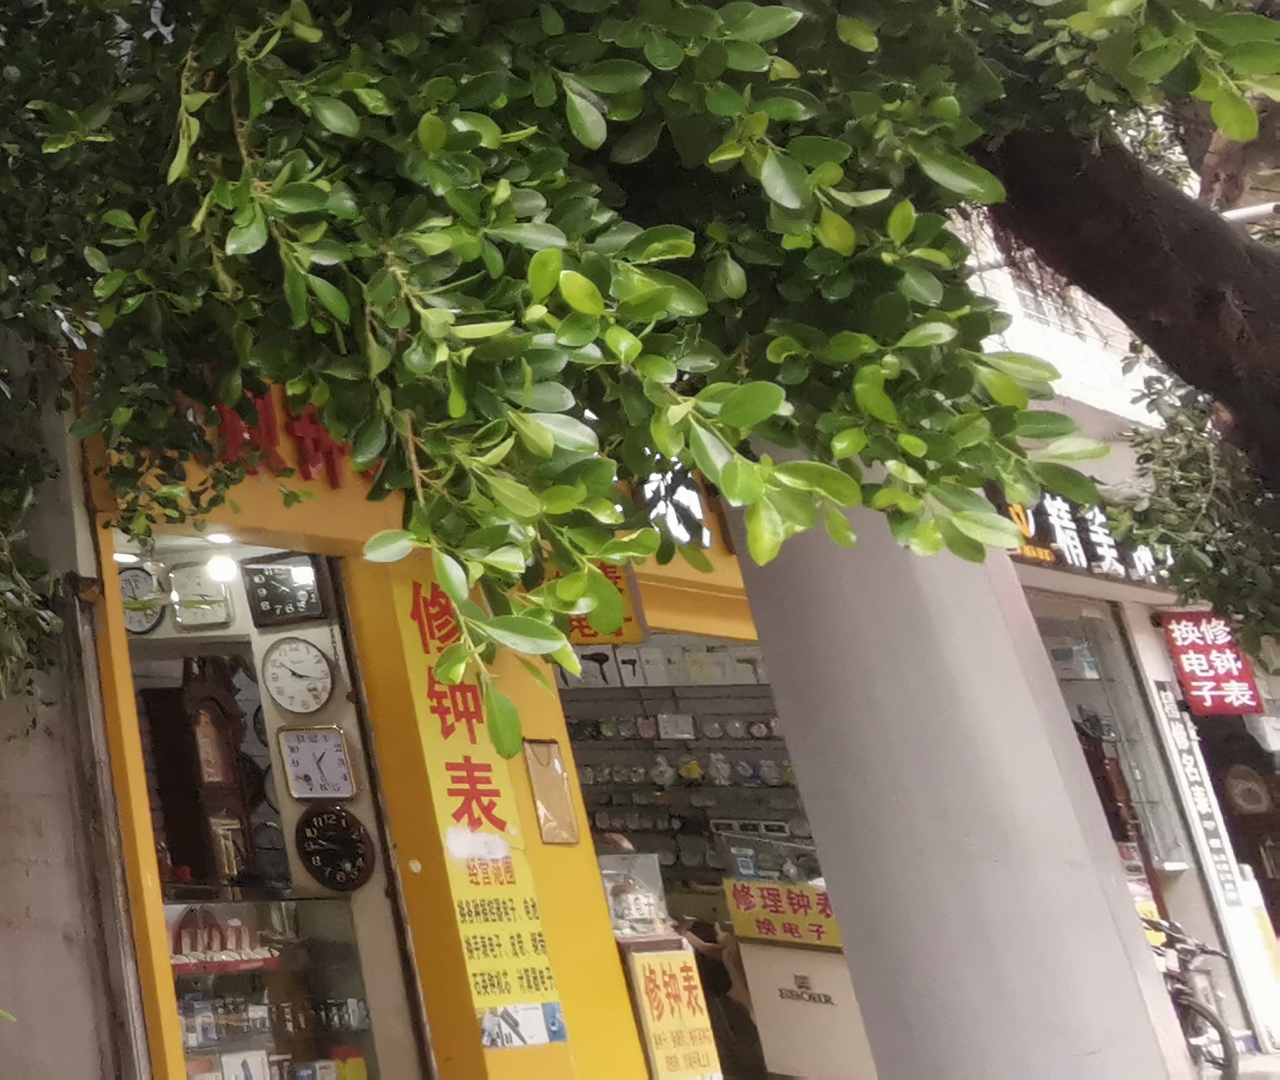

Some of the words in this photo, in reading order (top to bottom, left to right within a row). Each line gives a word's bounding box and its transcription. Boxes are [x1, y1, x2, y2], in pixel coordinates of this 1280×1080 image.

[410, 580, 508, 832] 修钟表
[756, 918, 827, 940] 换电子
[642, 962, 704, 1022] 修钟表
